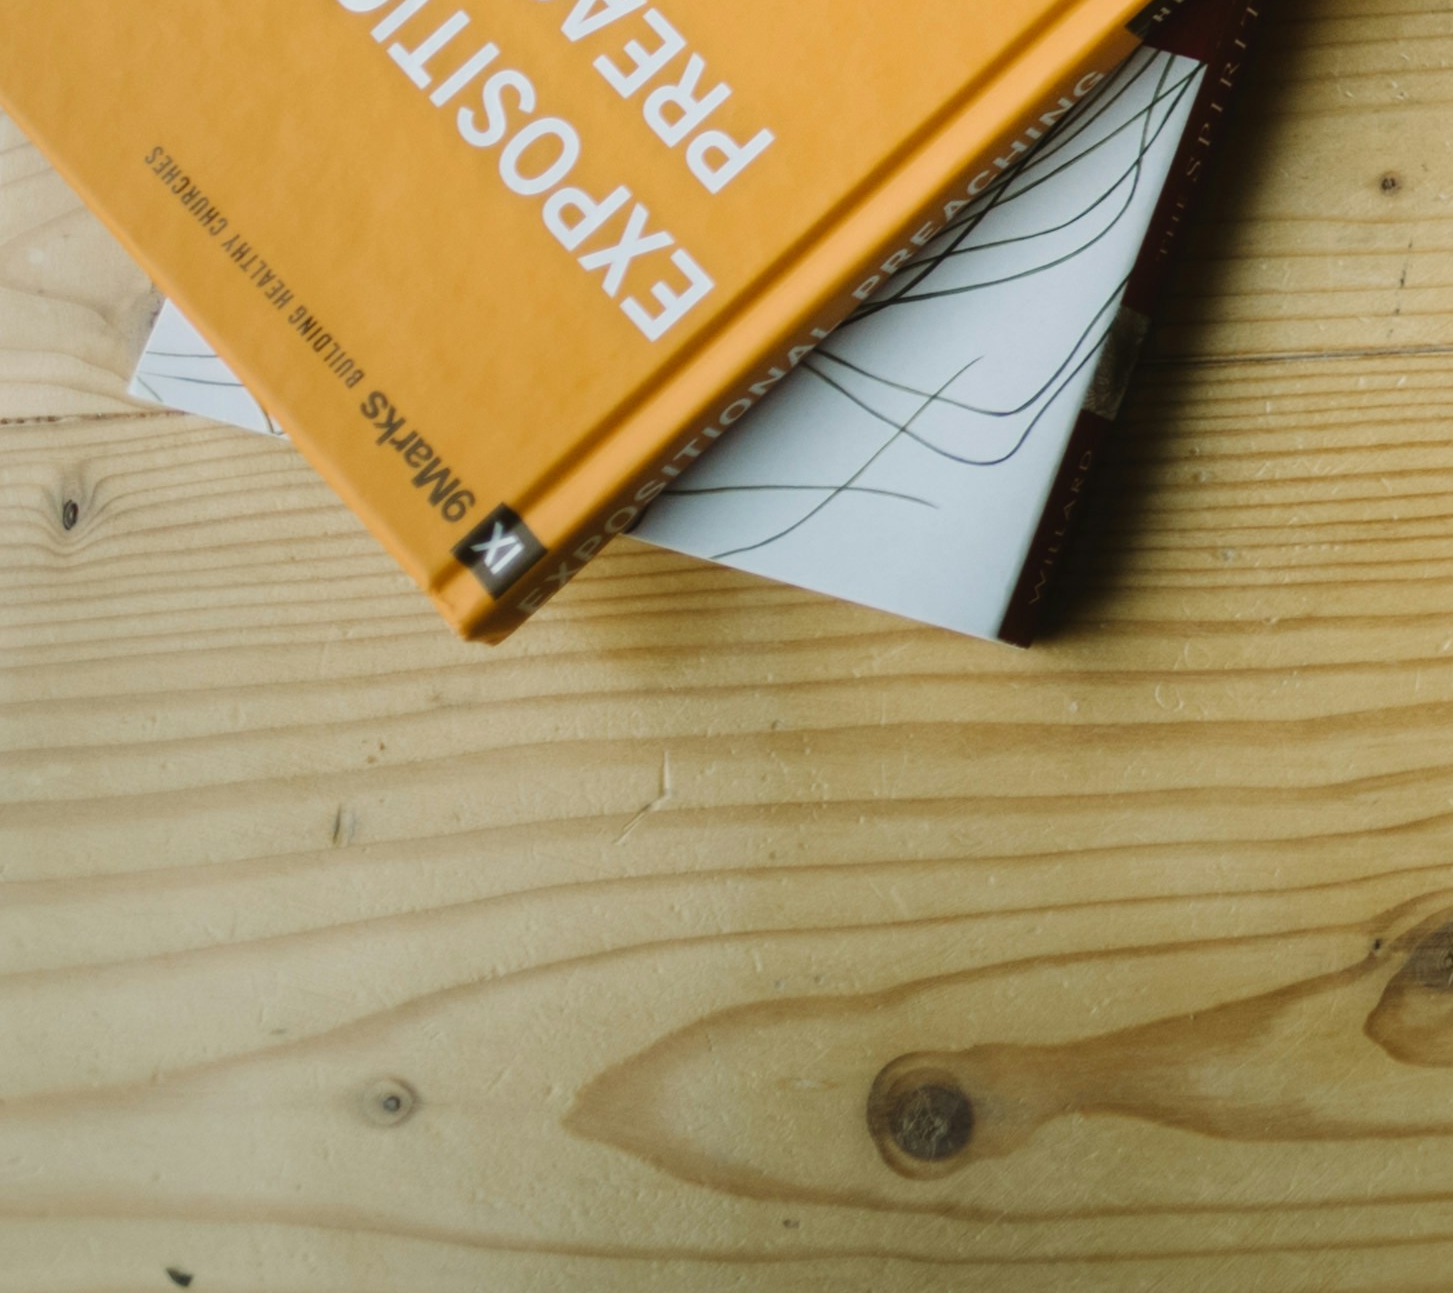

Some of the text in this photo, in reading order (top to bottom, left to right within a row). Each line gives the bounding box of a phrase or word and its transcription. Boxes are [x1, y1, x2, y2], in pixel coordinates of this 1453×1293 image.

[144, 145, 477, 524] 9Marks BUILDING HEALTHY CHURCHES
[516, 69, 1105, 614] EXPOSITIONAL PREACHING
[1027, 450, 1093, 606] WILLARD
